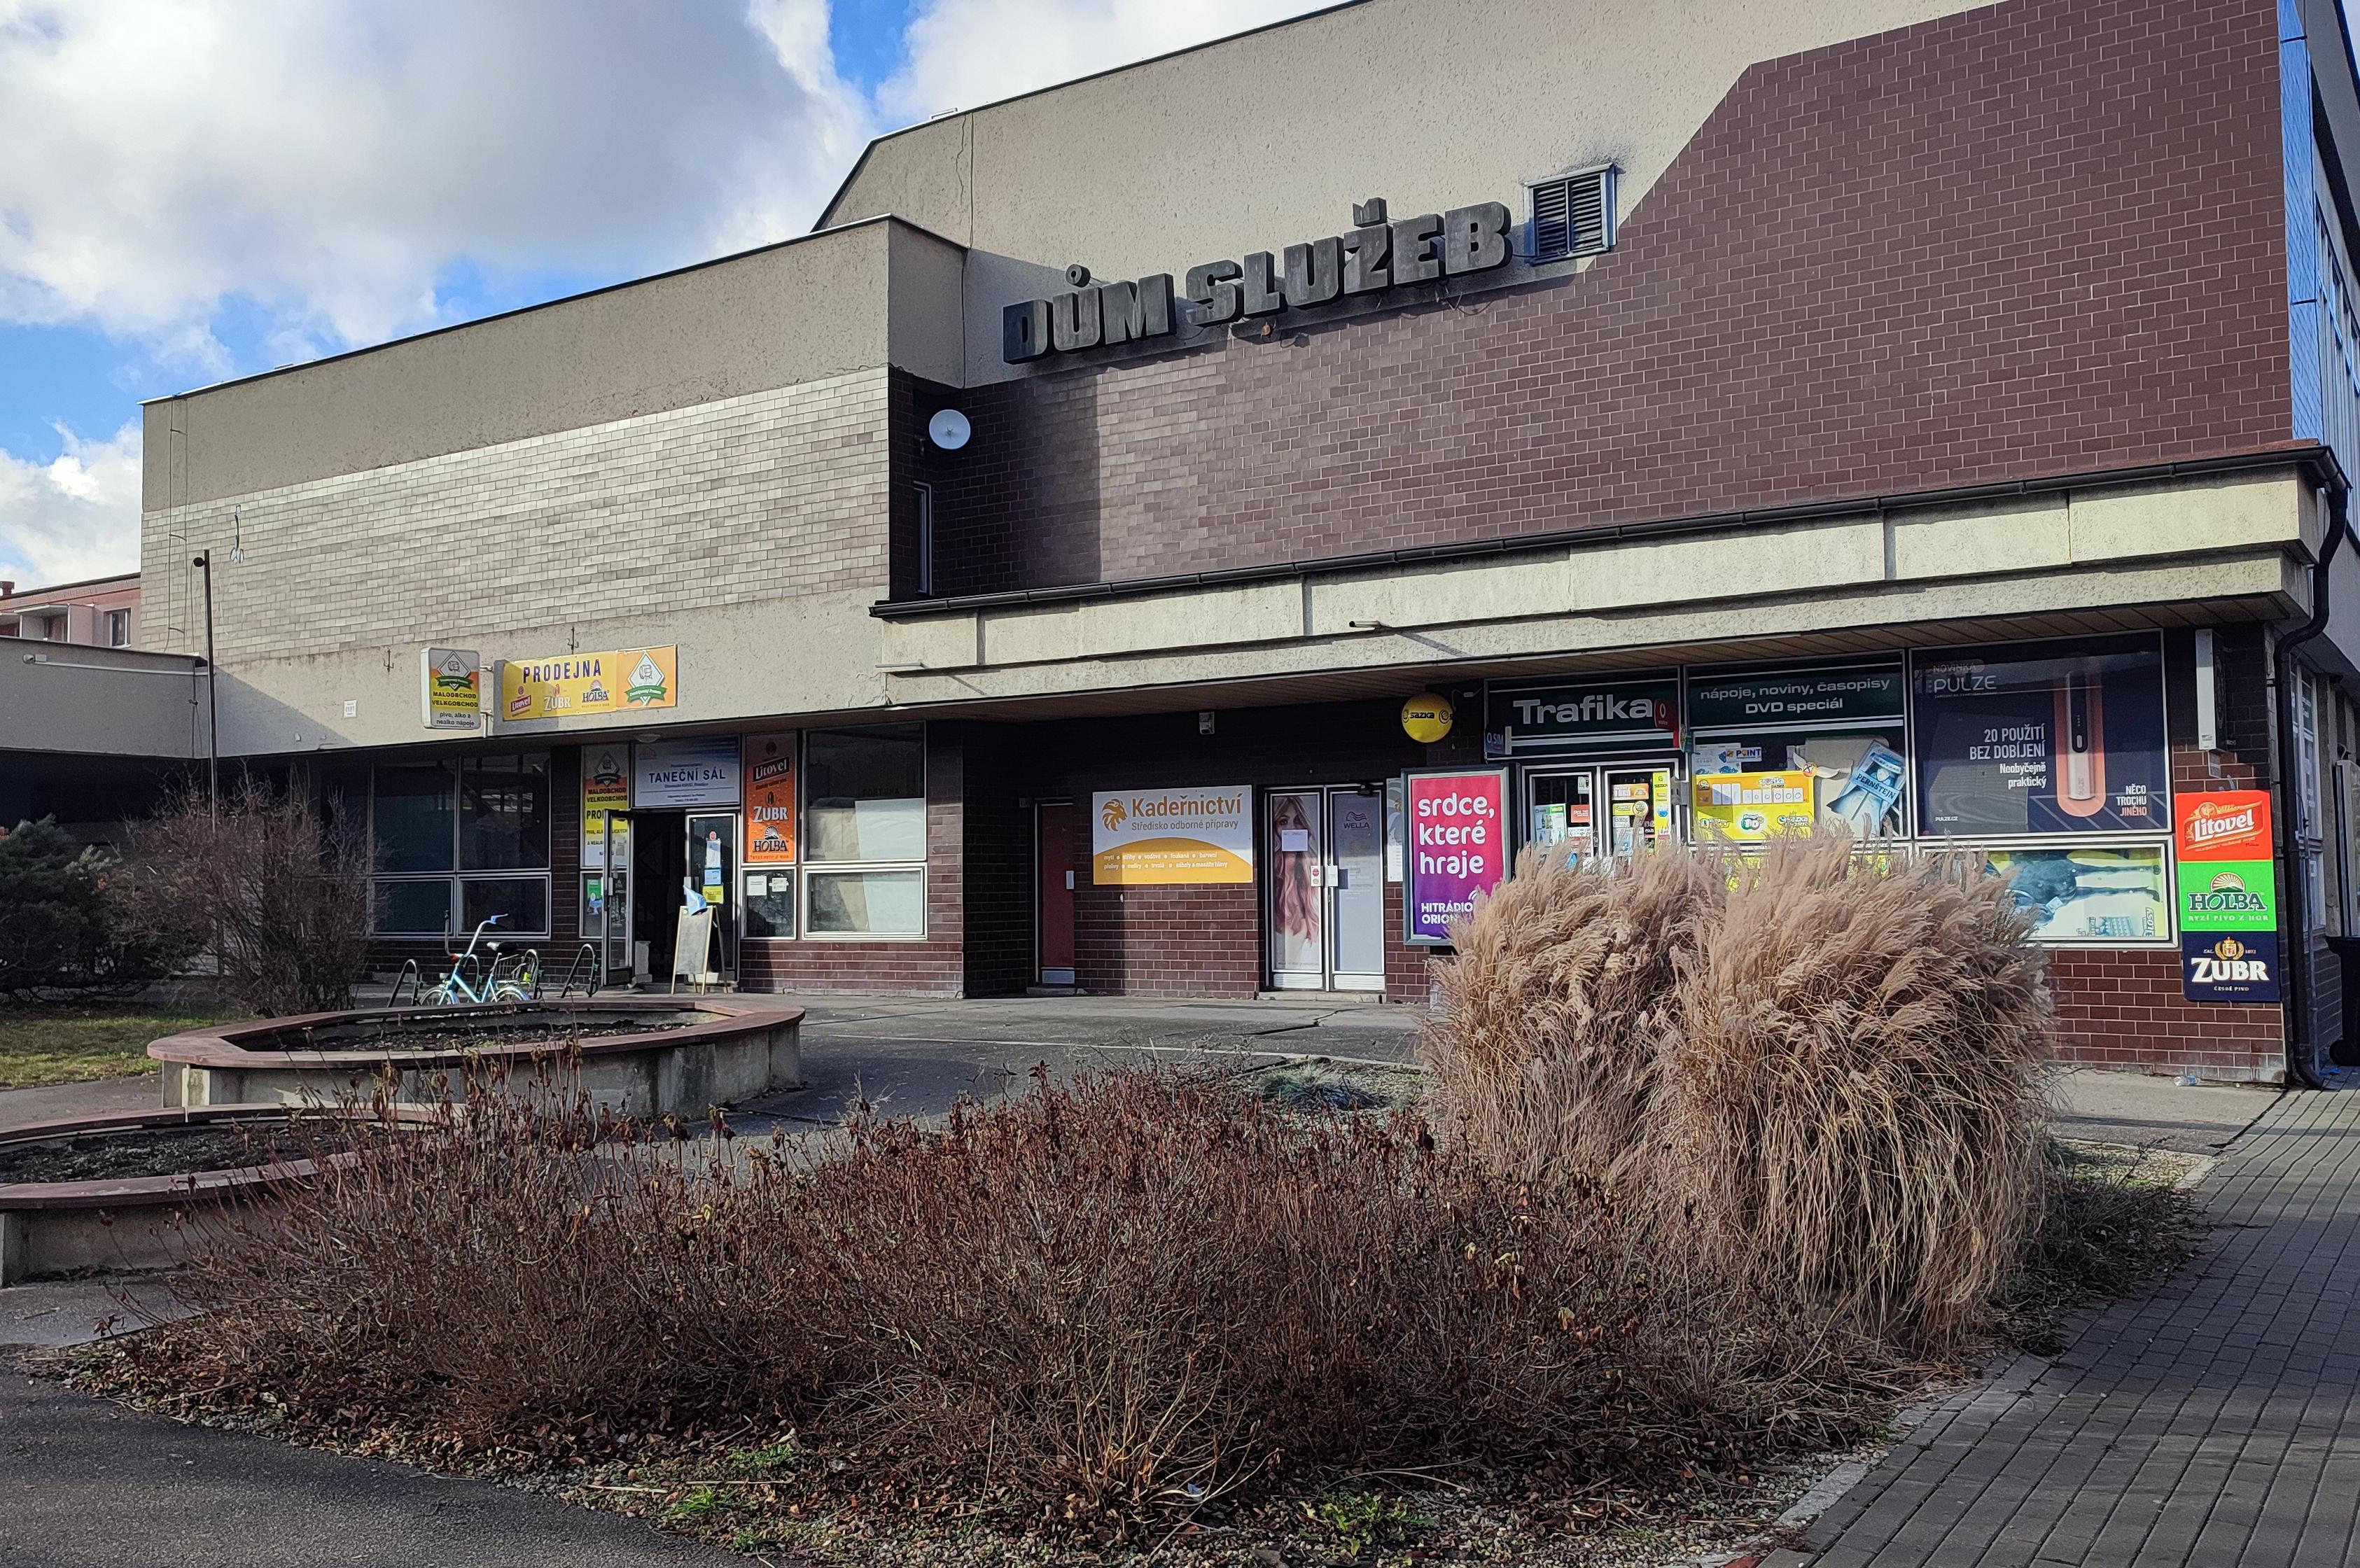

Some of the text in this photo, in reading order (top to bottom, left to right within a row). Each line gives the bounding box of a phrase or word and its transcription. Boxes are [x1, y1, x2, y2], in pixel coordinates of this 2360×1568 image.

[1003, 197, 1513, 365] DŮM SLUŽEB
[523, 659, 601, 684] PRODEJNA
[1700, 678, 1891, 701] nápoje, noviny, časopisy
[1934, 675, 1997, 694] PULZE
[543, 695, 571, 712] ZUBR
[582, 690, 609, 704] HOLBA
[1745, 698, 1843, 714] DVD speciál
[1513, 694, 1654, 724] Trafika
[1984, 723, 2045, 743] 20 POUŽITÍ
[1969, 739, 2046, 760] BEZ DOBÍJENÍ
[648, 766, 726, 783] TANEČNÍ SÁL
[755, 758, 788, 780] Litovel
[2008, 775, 2047, 790] praktický
[2125, 783, 2146, 795] NĚCO
[1131, 793, 1243, 818] Kadeřnictví
[1418, 792, 1495, 819] srdce,
[2116, 795, 2147, 806] TROCHU
[753, 806, 789, 823] ZUBR
[2120, 806, 2147, 817] JINÉHO
[1131, 819, 1238, 832] Středisko odborné přípravy
[1418, 819, 1486, 846] které
[2194, 808, 2255, 842] Litovel
[753, 839, 788, 853] HOLBA
[1420, 850, 1484, 879] hraje
[1420, 899, 1474, 913] HITRÁDIO
[2188, 892, 2268, 912] HOLBA
[2191, 957, 2270, 983] ZUBR
